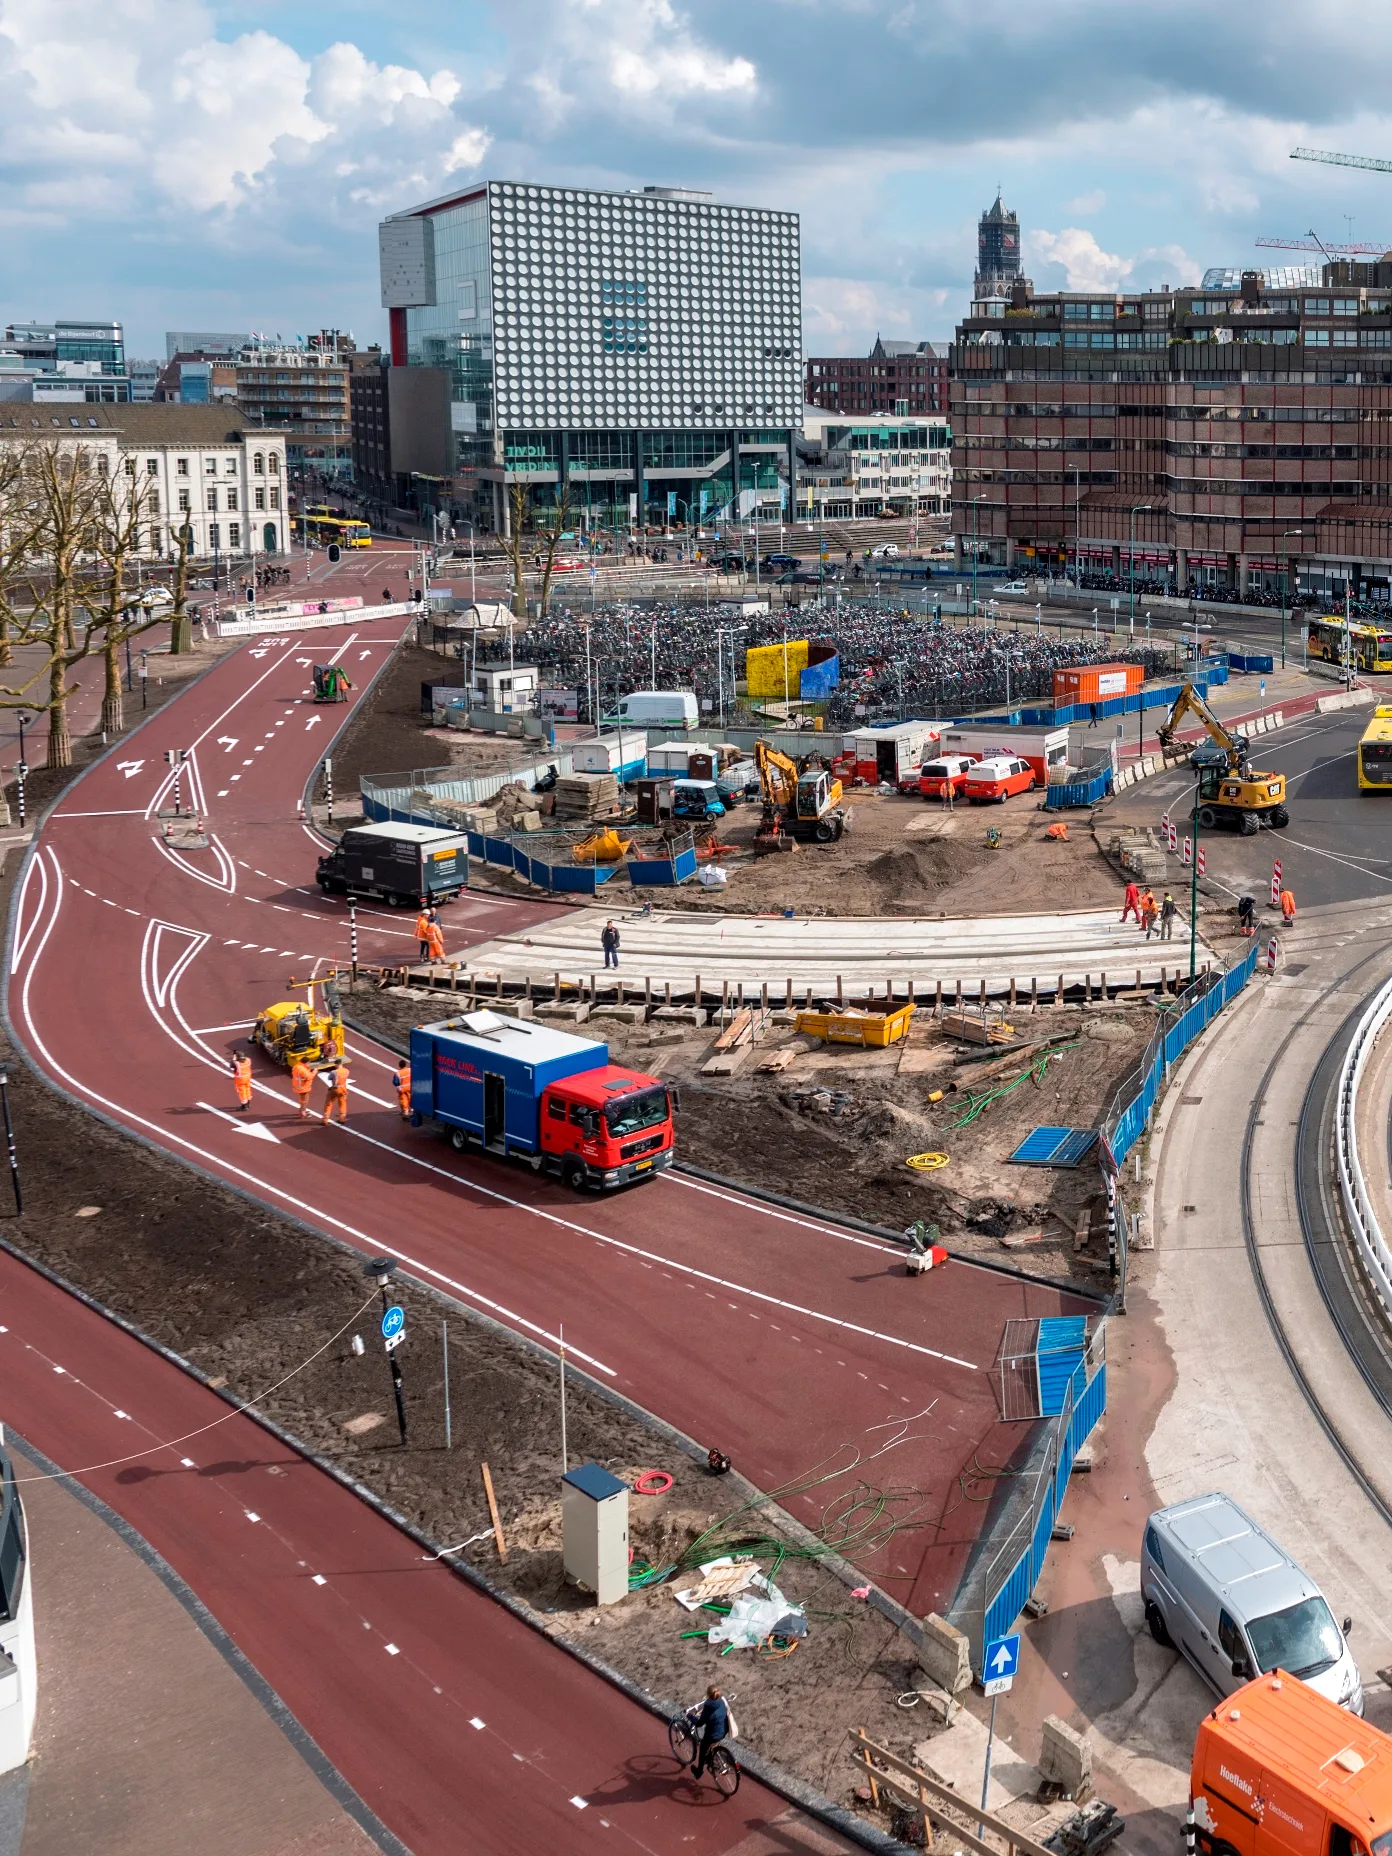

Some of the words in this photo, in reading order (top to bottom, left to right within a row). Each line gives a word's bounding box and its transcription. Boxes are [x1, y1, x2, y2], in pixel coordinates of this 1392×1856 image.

[506, 446, 546, 457] TIVOLI
[1220, 1764, 1253, 1796] Hoeflake
[1268, 1800, 1304, 1832] Electrotechniek
